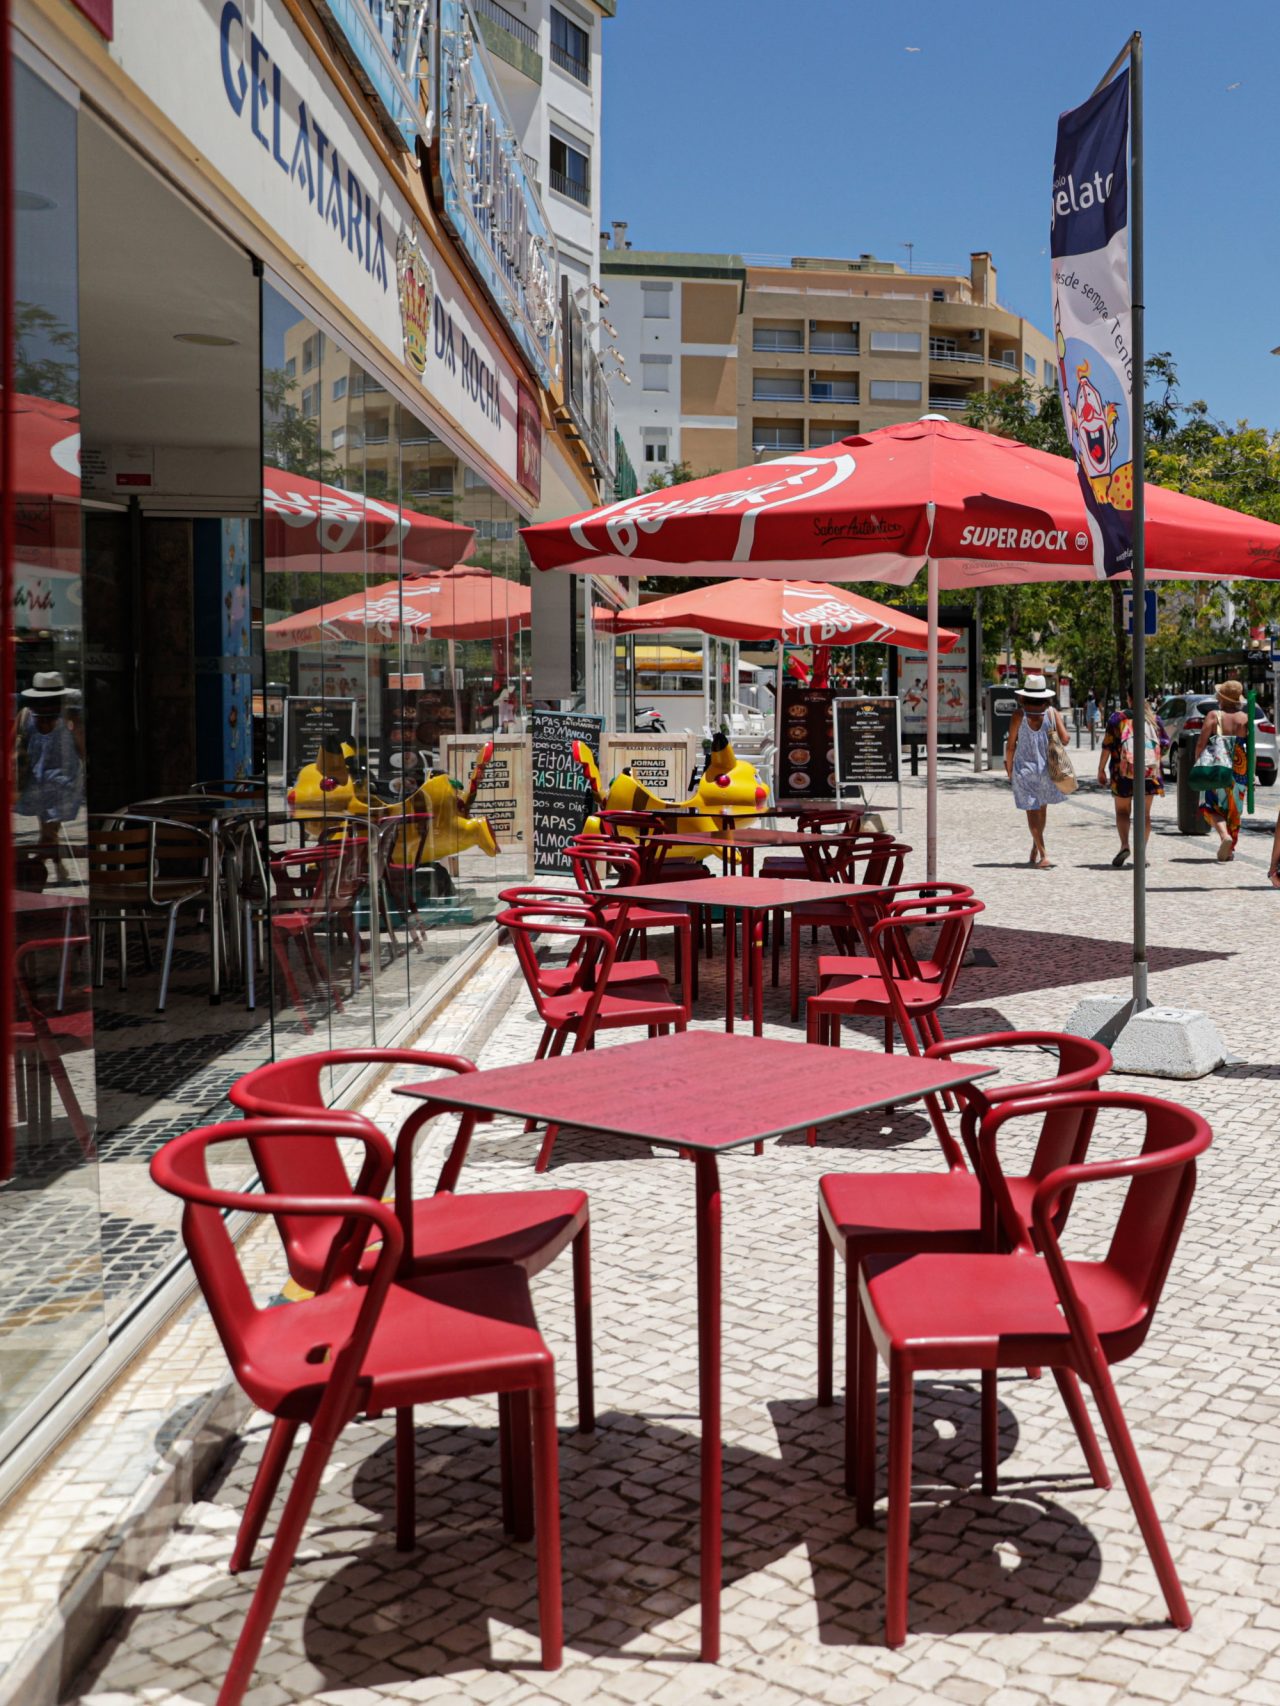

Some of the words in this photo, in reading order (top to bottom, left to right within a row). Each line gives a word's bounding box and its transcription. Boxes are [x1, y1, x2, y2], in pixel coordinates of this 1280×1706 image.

[219, 1, 389, 294] GELATARIA
[1081, 283, 1109, 321] sempre
[434, 292, 456, 377] DA
[461, 332, 501, 432] ROCHA
[960, 525, 1018, 548] SUPER
[1019, 529, 1068, 550] BOCK
[794, 601, 851, 622] SUPER
[820, 609, 869, 640] BOCK
[556, 725, 593, 742] MANOLO
